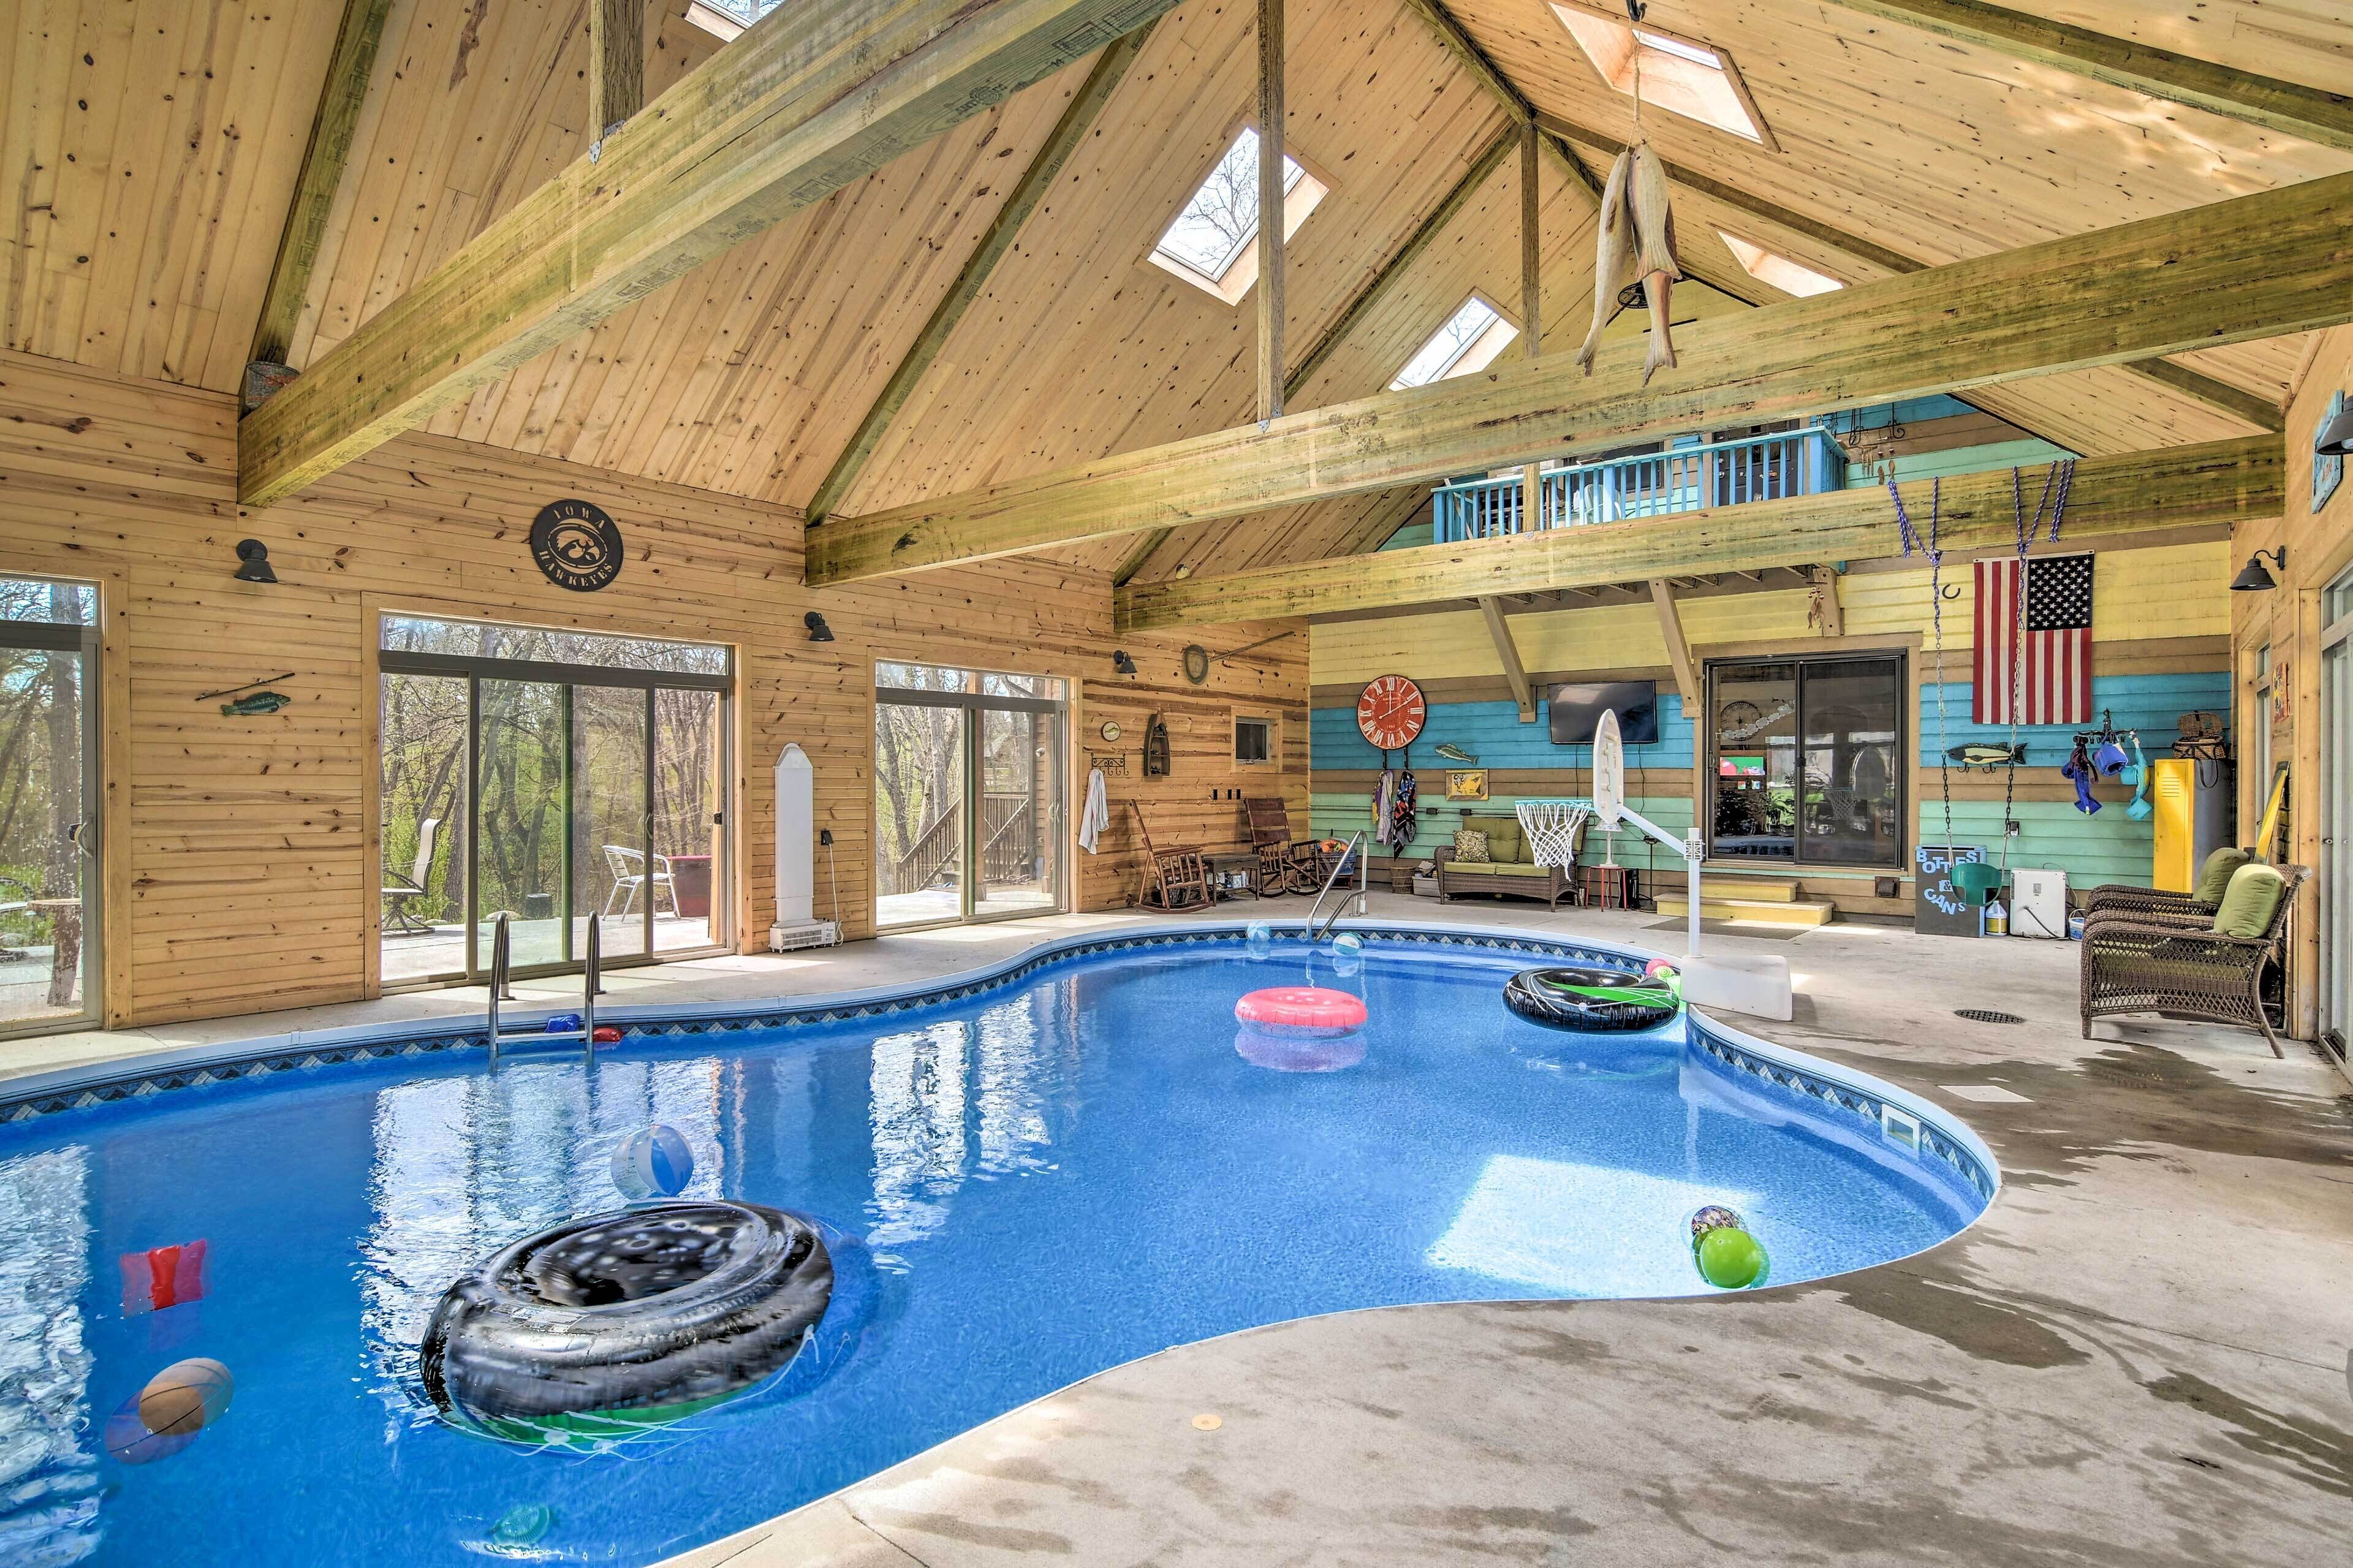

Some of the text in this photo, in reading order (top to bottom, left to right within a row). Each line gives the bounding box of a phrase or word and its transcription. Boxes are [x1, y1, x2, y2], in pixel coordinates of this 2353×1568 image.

[553, 505, 605, 529] IOWA
[539, 550, 613, 586] HAWKEYES
[1916, 850, 1977, 873] BOTTES
[1924, 888, 1966, 915] CANS
